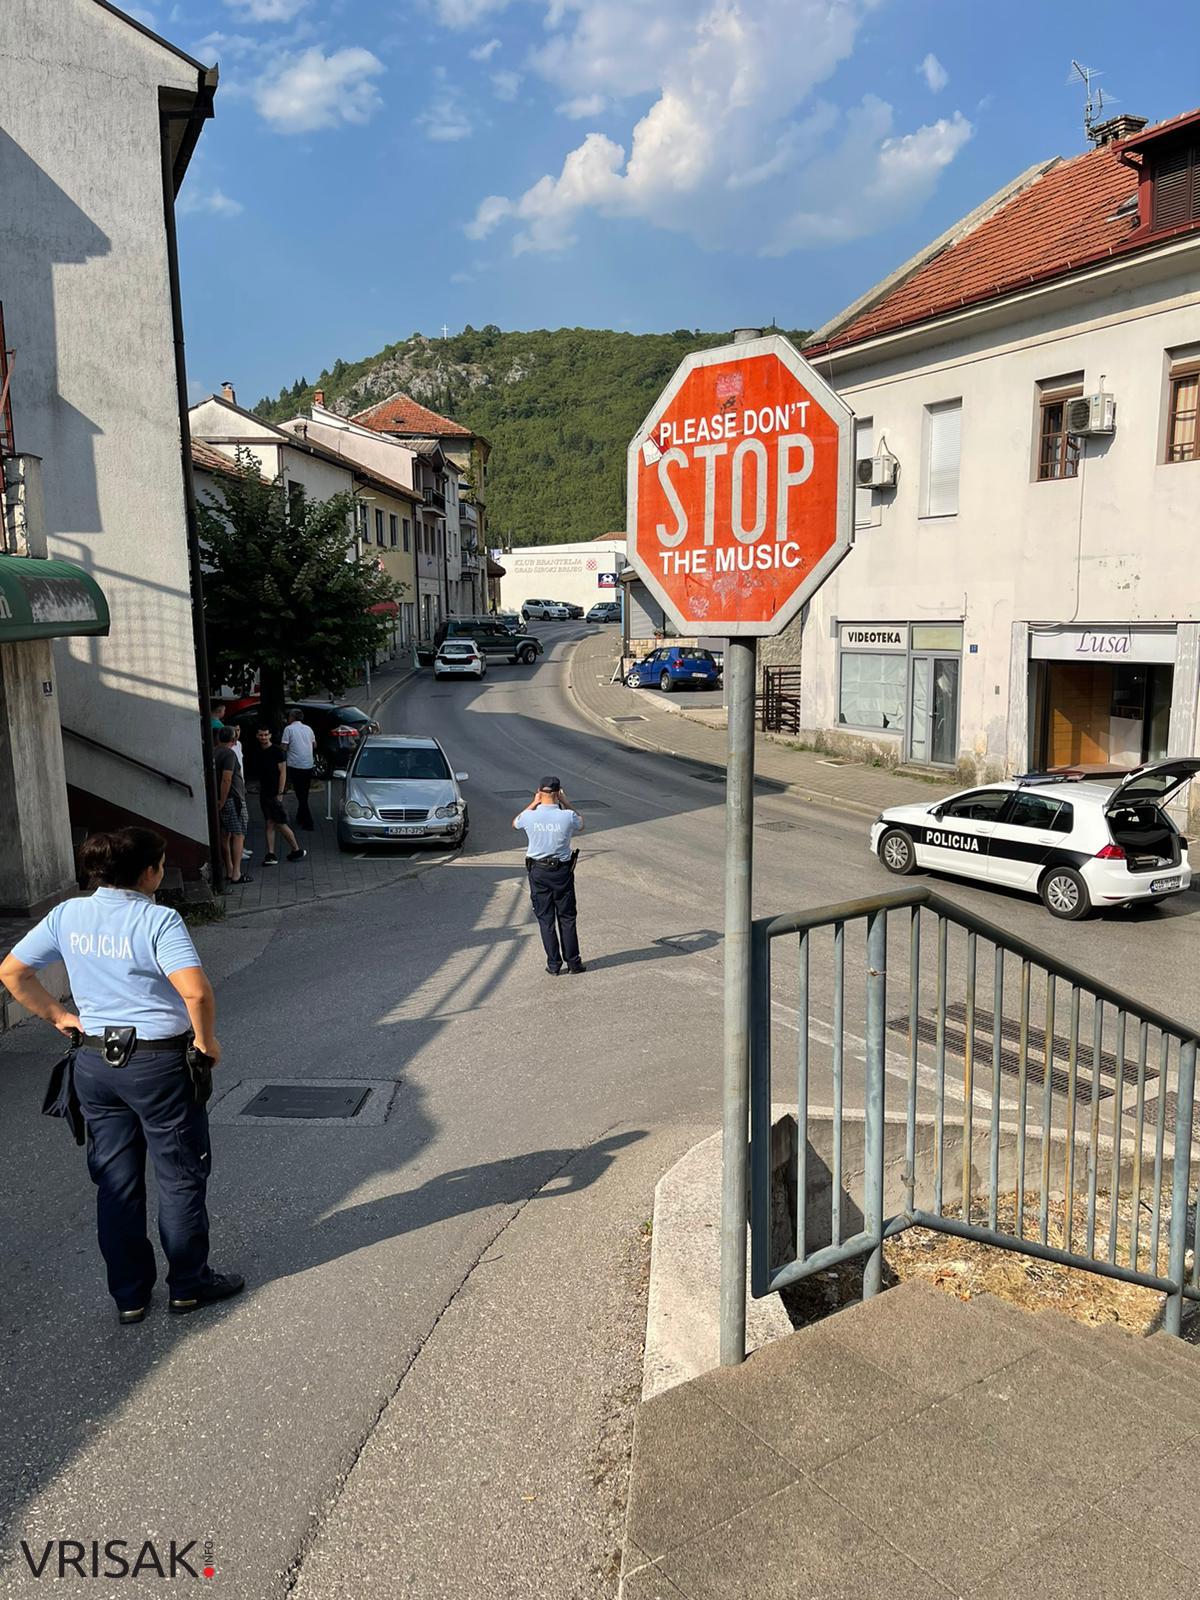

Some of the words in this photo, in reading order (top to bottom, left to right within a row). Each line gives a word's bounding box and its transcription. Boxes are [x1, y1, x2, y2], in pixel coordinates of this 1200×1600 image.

[660, 412, 737, 446] PLEASE
[743, 401, 810, 436] DON'T
[656, 433, 814, 548] STOP
[659, 549, 706, 575] THE
[715, 541, 801, 572] MUSIC
[848, 631, 901, 644] VIDEOTEKA
[1076, 630, 1129, 653] Lusa
[534, 823, 561, 832] POLICIJA
[926, 830, 979, 852] POLICIJA
[70, 932, 133, 960] POLICIJA
